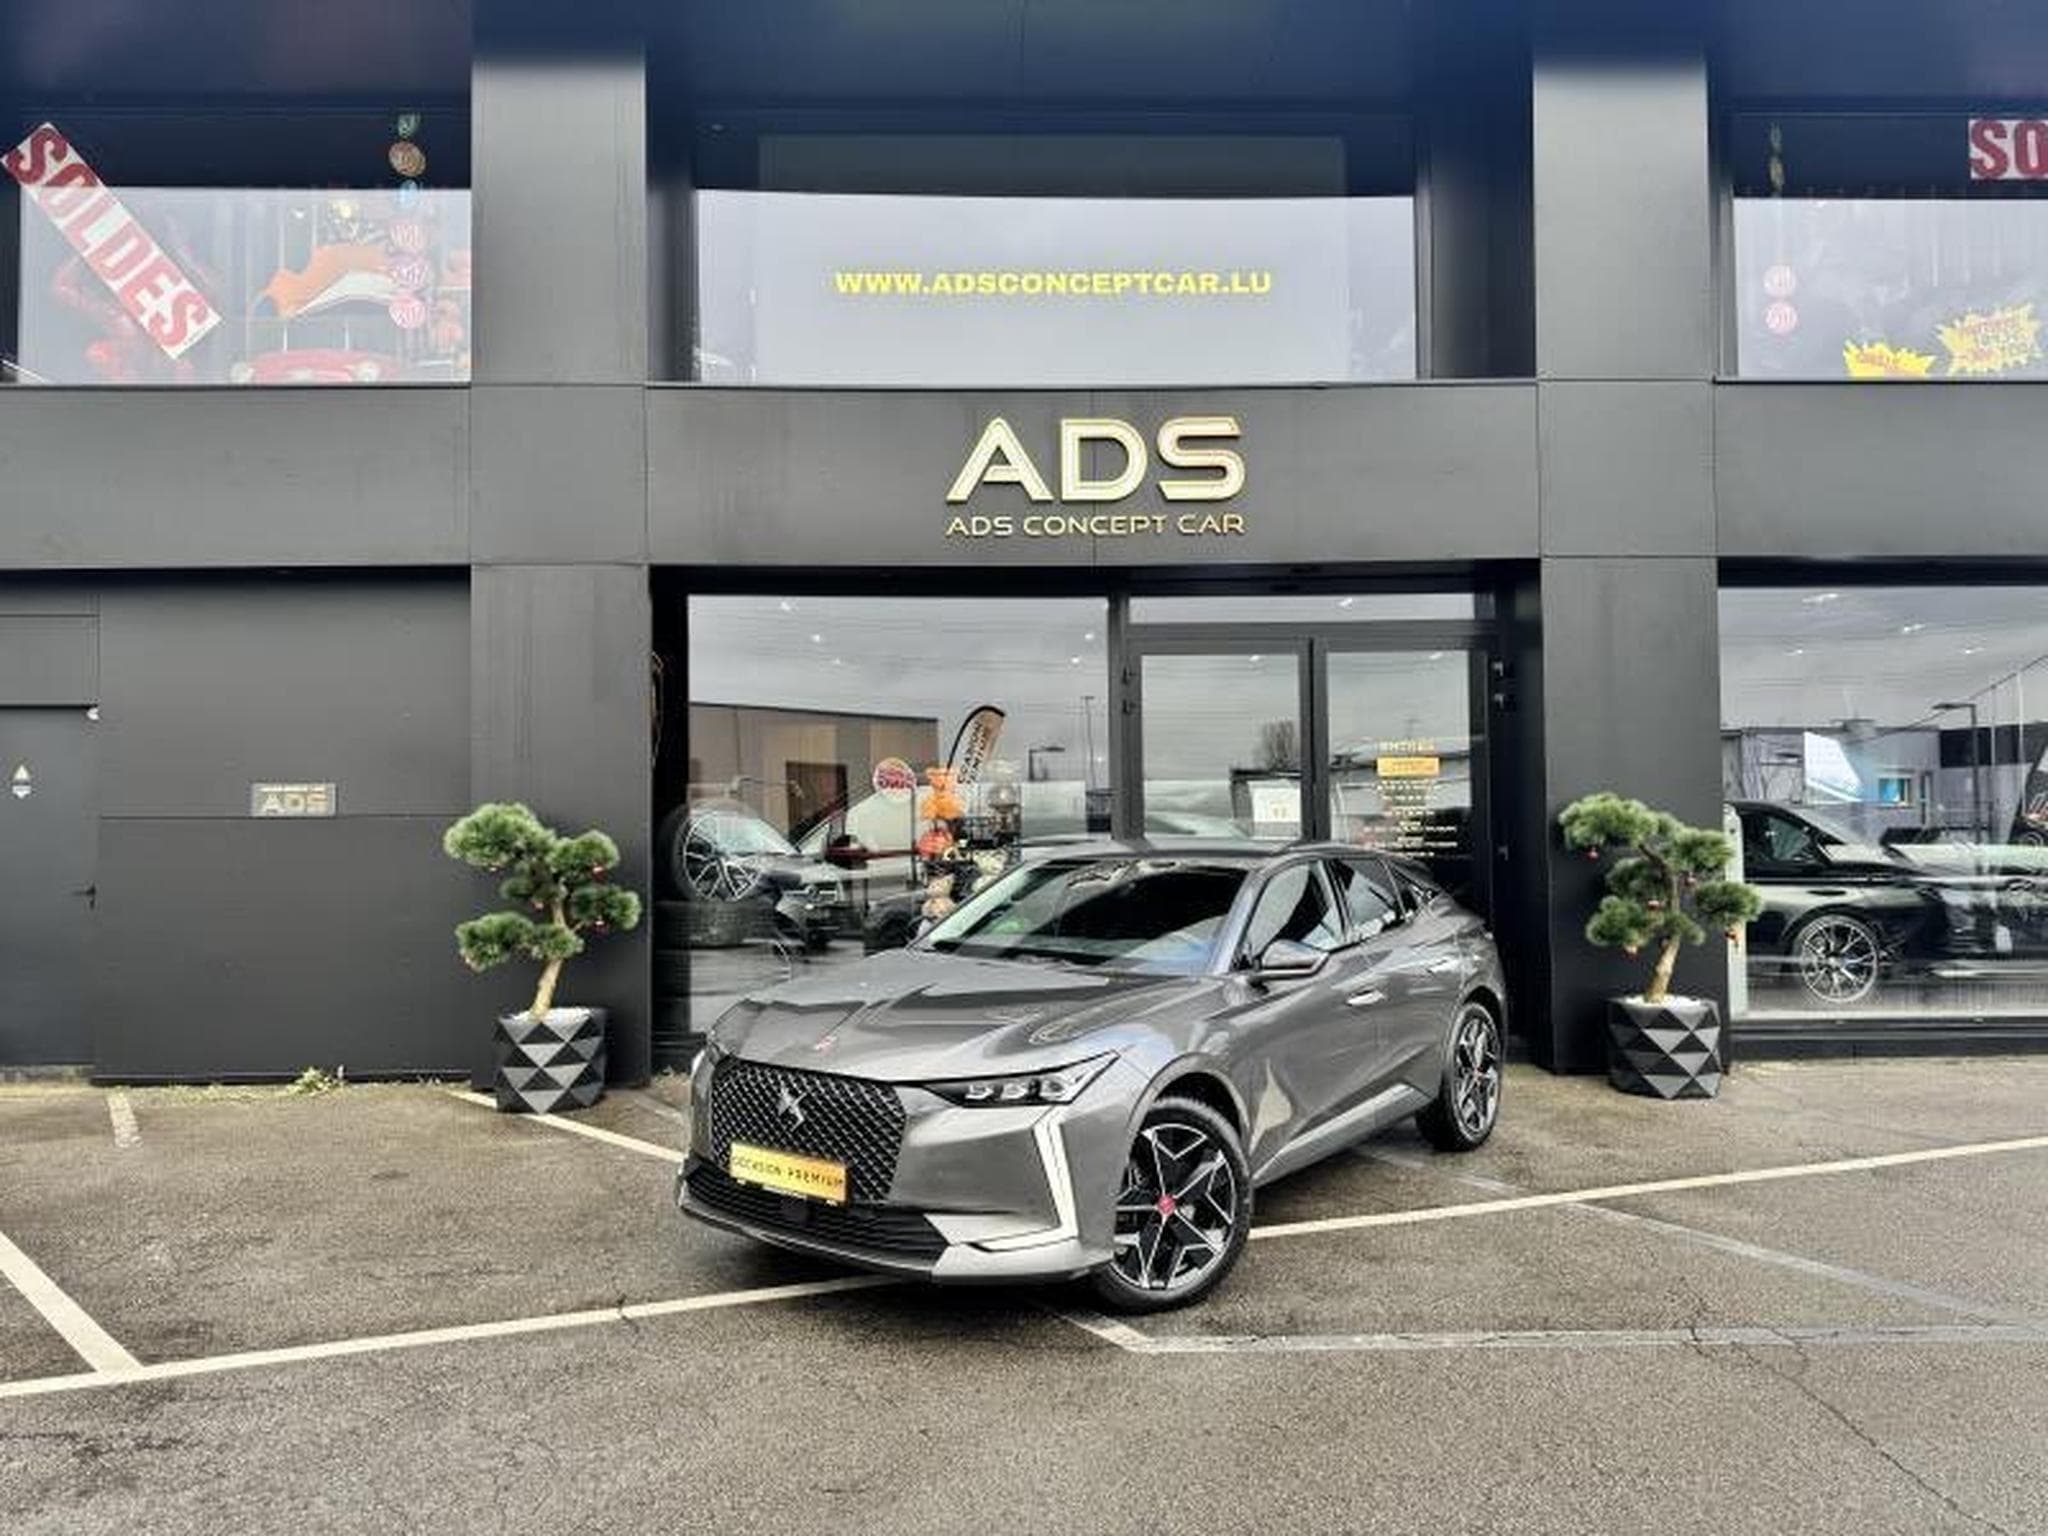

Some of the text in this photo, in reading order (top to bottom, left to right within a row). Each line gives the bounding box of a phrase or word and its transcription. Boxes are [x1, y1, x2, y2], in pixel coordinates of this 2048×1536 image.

[7, 127, 208, 347] SOLDES
[835, 271, 1272, 295] WWW.ADSCONCEPTCAR.LU
[946, 416, 1246, 503] ADS
[946, 514, 1246, 537] ADS CONCEPT CAR
[787, 1165, 844, 1188] PREMIUM
